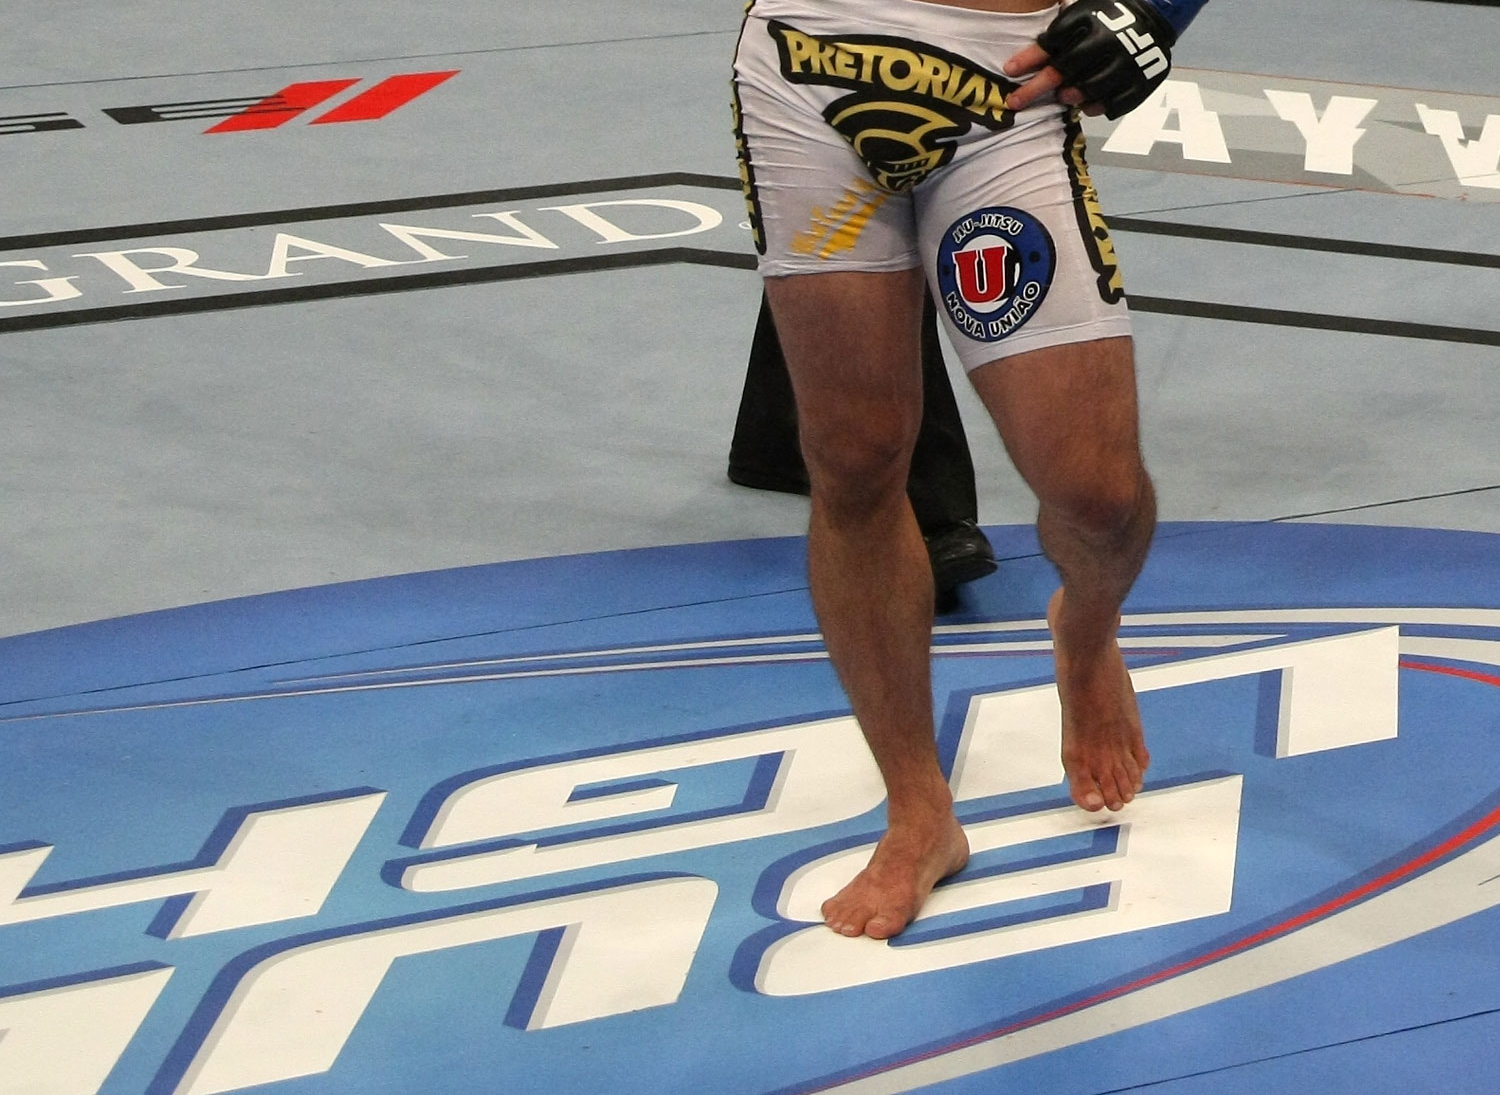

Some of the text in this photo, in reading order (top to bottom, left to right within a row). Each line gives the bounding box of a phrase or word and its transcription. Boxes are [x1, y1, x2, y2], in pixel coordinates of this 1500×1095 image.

[779, 29, 1010, 123] PRETORIAN
[1097, 1, 1169, 81] UFC
[0, 199, 724, 308] GRAND
[952, 213, 1024, 244] JIU-JITSU
[951, 245, 1008, 305] U
[946, 291, 986, 339] NOVA
